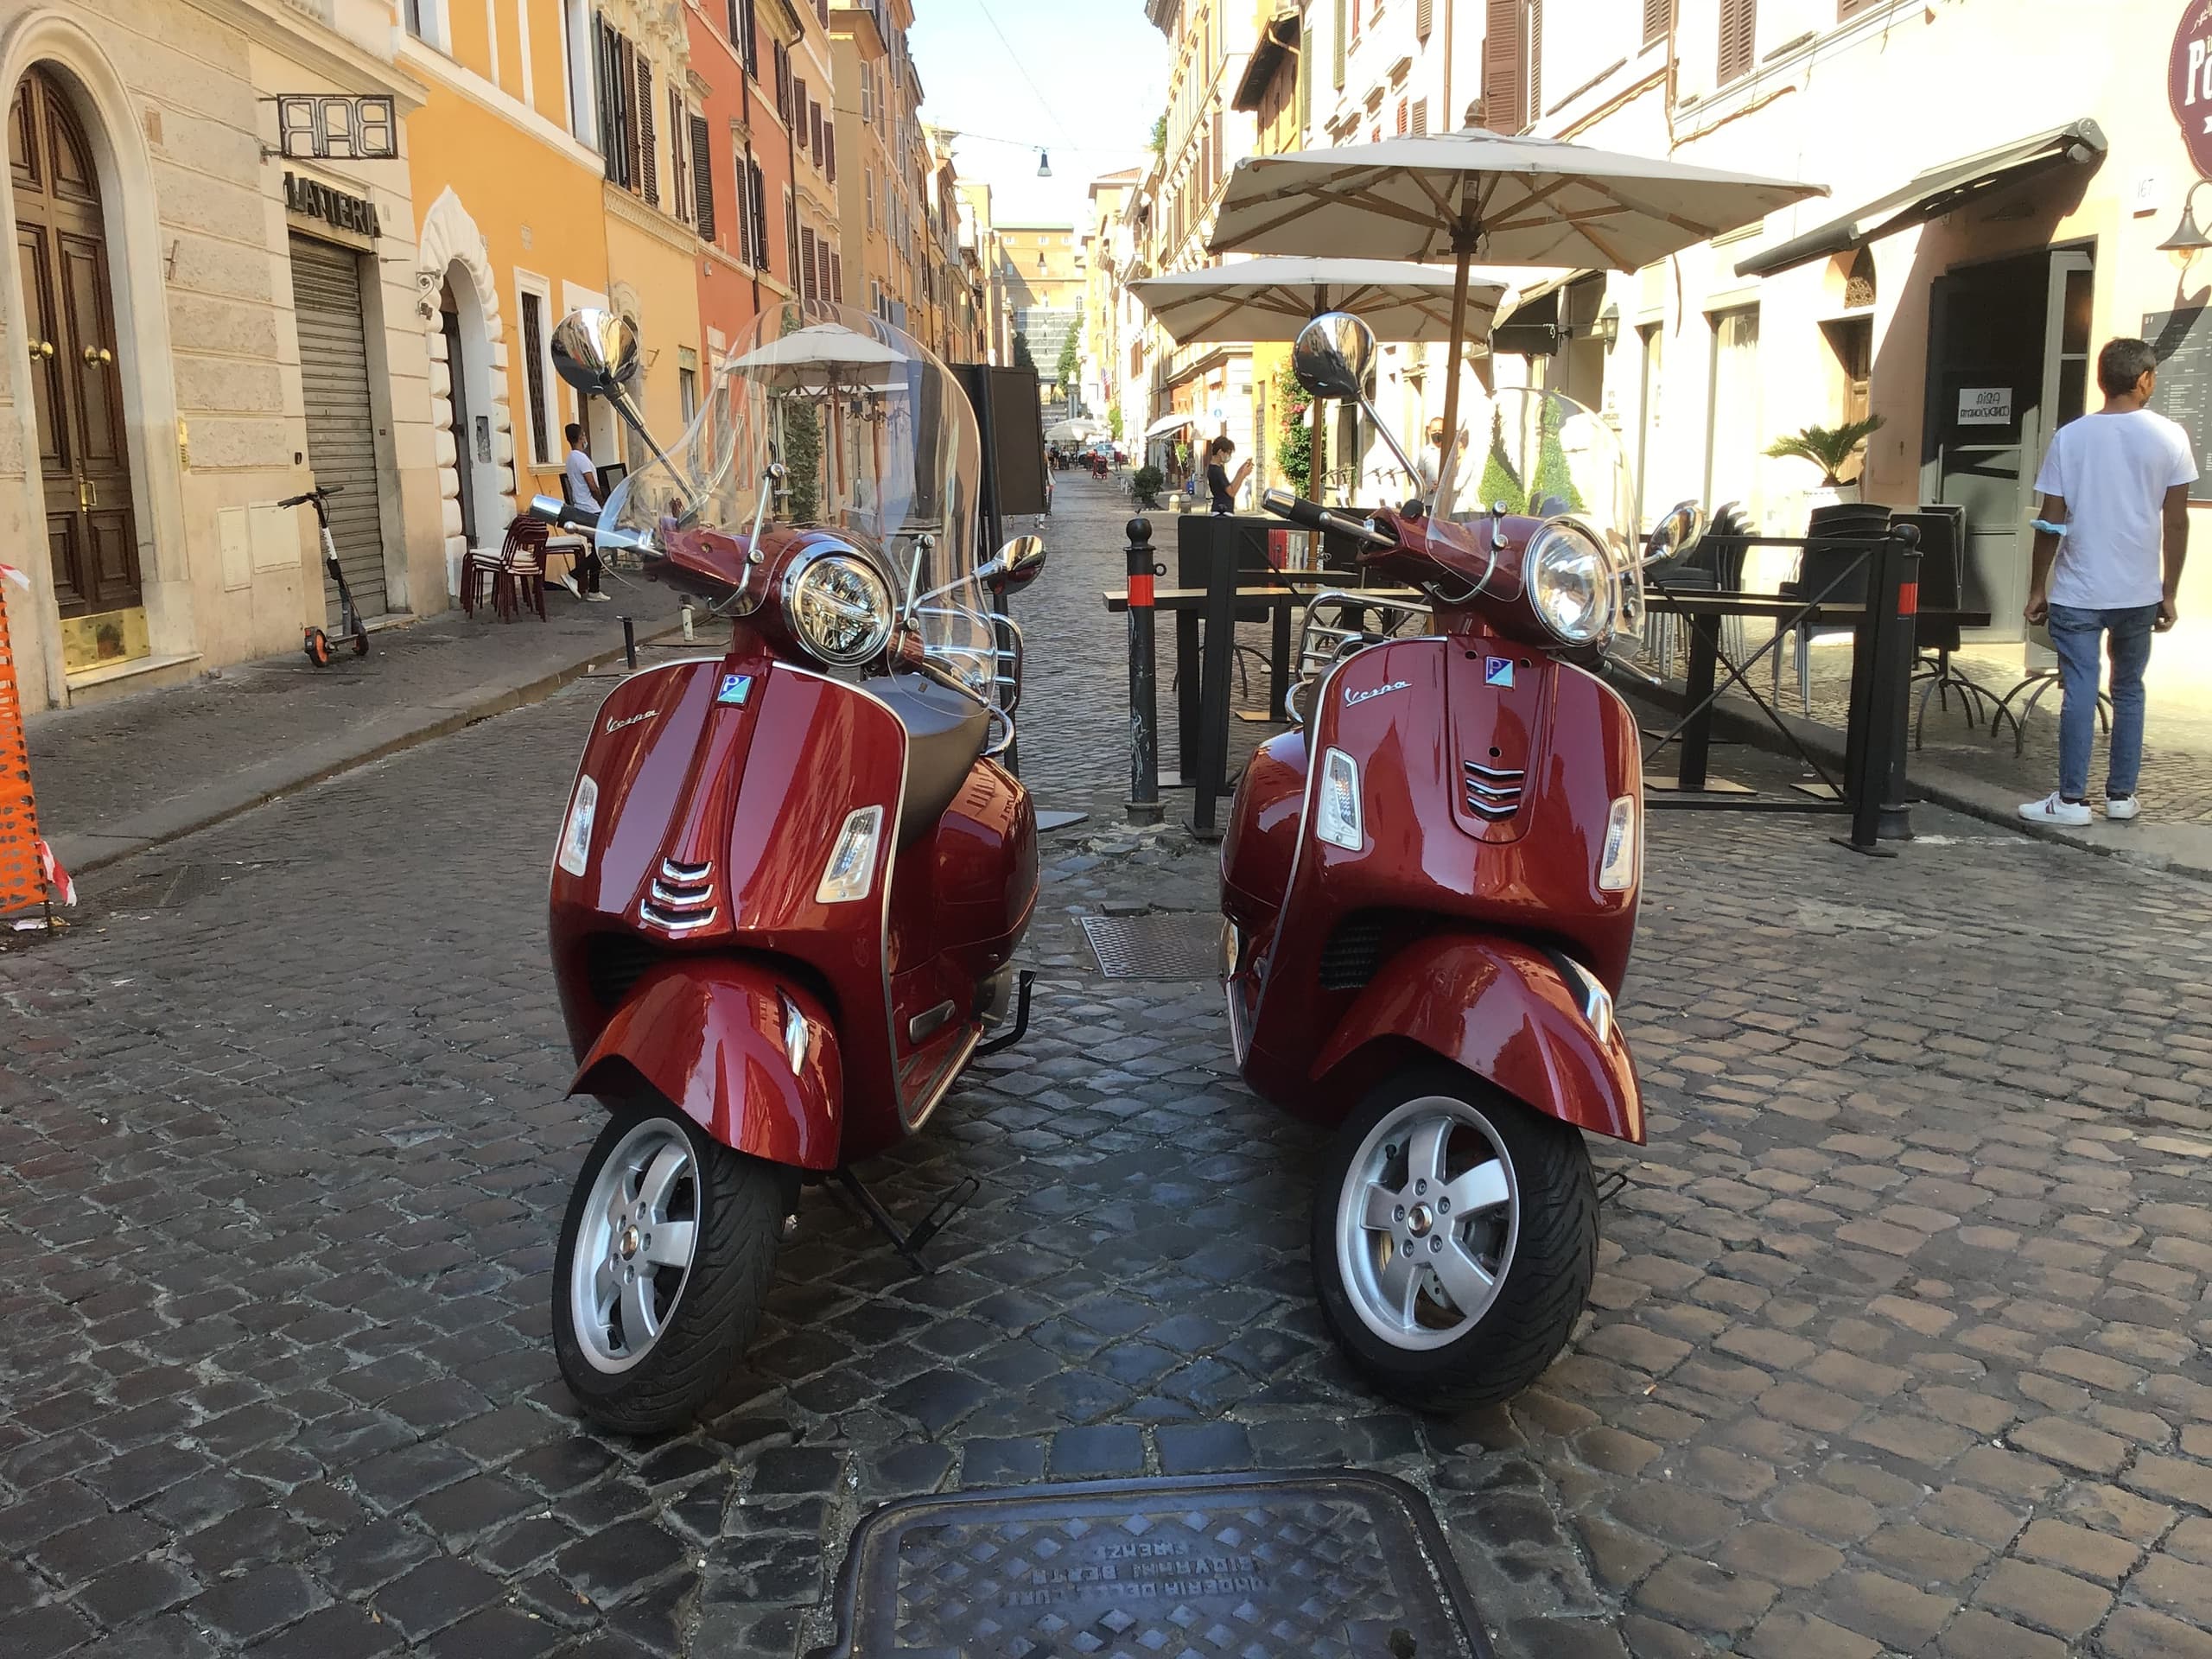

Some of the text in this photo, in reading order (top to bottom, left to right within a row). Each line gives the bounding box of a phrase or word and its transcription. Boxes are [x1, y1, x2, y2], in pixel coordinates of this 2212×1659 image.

[283, 171, 382, 238] LATTERIA
[1344, 680, 1413, 709] Vespa
[605, 709, 661, 736] Vespa
